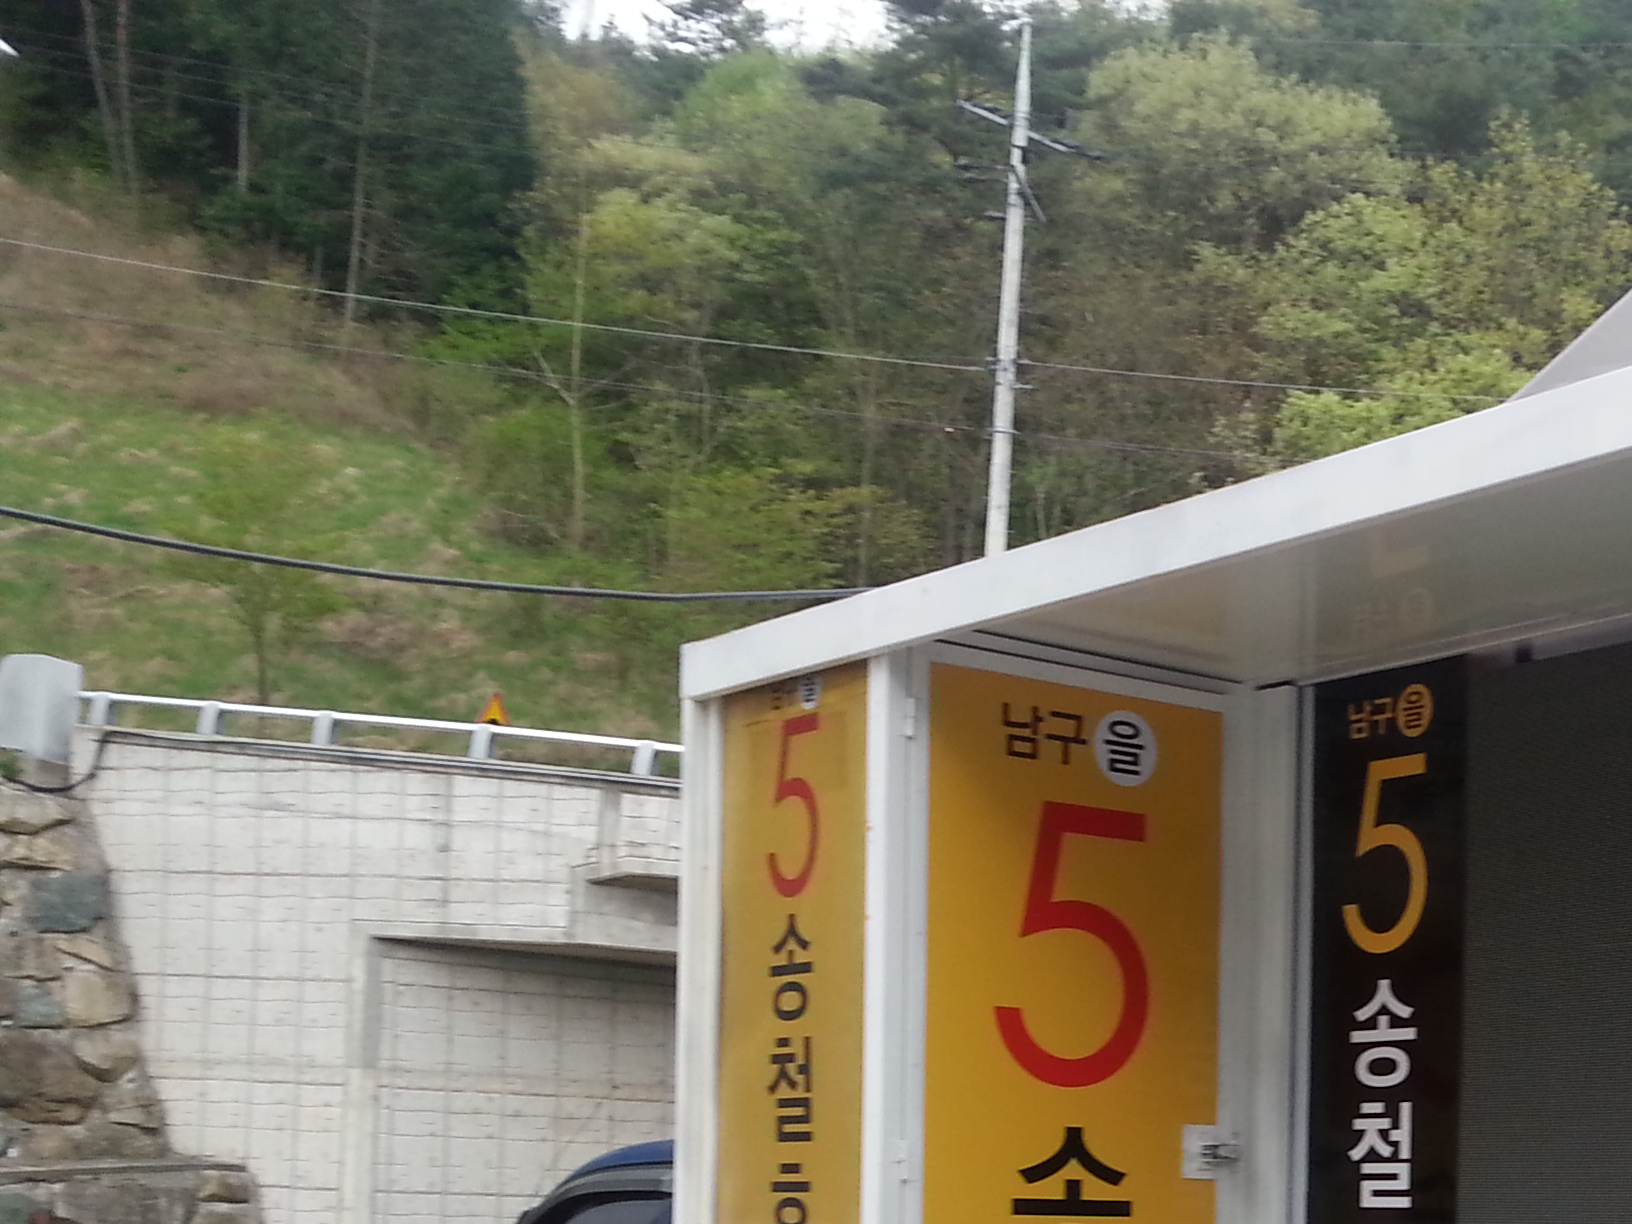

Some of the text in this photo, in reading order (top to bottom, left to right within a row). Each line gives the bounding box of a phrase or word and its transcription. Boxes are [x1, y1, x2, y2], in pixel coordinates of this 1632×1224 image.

[768, 711, 819, 898] 5
[1341, 752, 1428, 954] 5
[993, 800, 1150, 1088] 5
